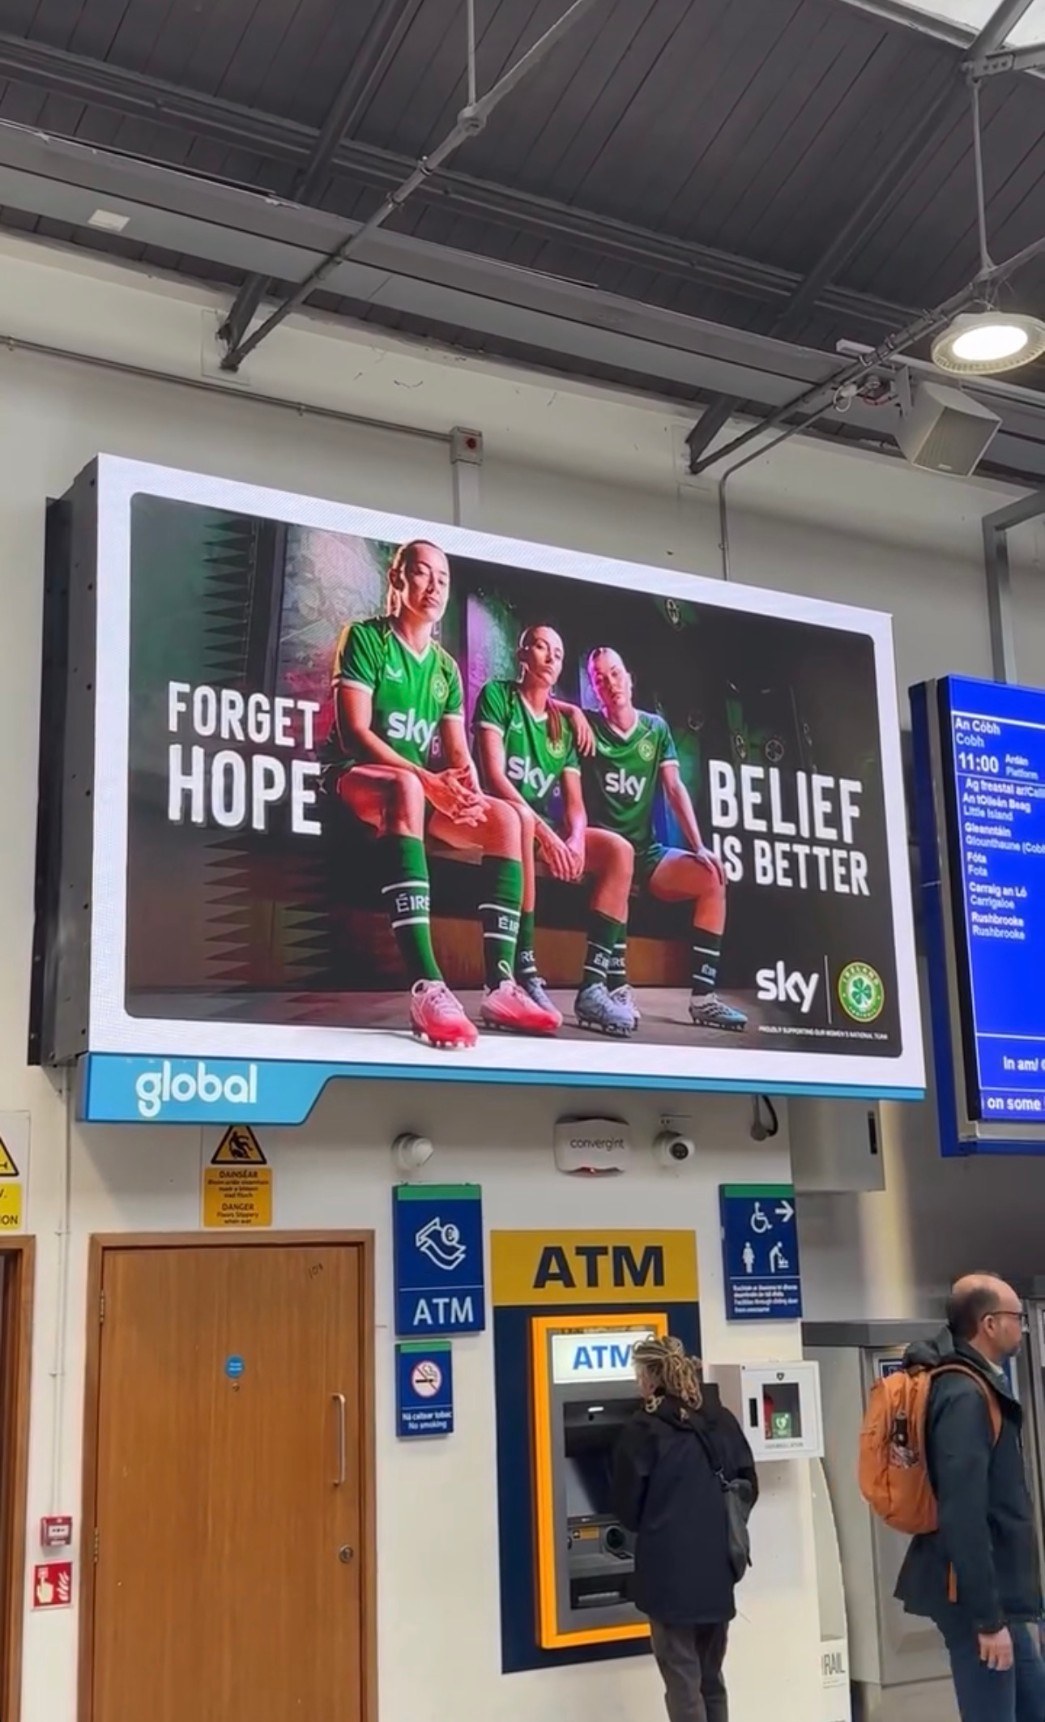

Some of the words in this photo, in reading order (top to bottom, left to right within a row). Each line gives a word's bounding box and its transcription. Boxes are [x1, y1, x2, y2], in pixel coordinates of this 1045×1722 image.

[168, 681, 320, 751] FORGET
[387, 708, 437, 752] sky
[955, 717, 971, 730] An
[956, 732, 985, 748] Cobh
[508, 755, 555, 798] sky
[958, 752, 999, 773] 11:00
[168, 744, 322, 836] HOPE
[605, 767, 646, 801] sky
[963, 792, 976, 804] An
[708, 759, 862, 845] BELIEF
[963, 805, 985, 818] Little
[987, 808, 1013, 822] Island
[712, 832, 743, 883] IS
[755, 838, 870, 897] BETTER
[968, 864, 988, 878] Fota
[971, 911, 1025, 928] Rushbrooke
[972, 924, 1026, 940] Rushbrooke
[756, 960, 819, 1014] sky
[136, 1061, 257, 1117] global
[987, 1097, 1004, 1110] on
[1006, 1098, 1042, 1111] some
[570, 1137, 624, 1152] convergint
[533, 1245, 665, 1289] ATM
[413, 1296, 474, 1327] ATM
[573, 1344, 632, 1370] ATM
